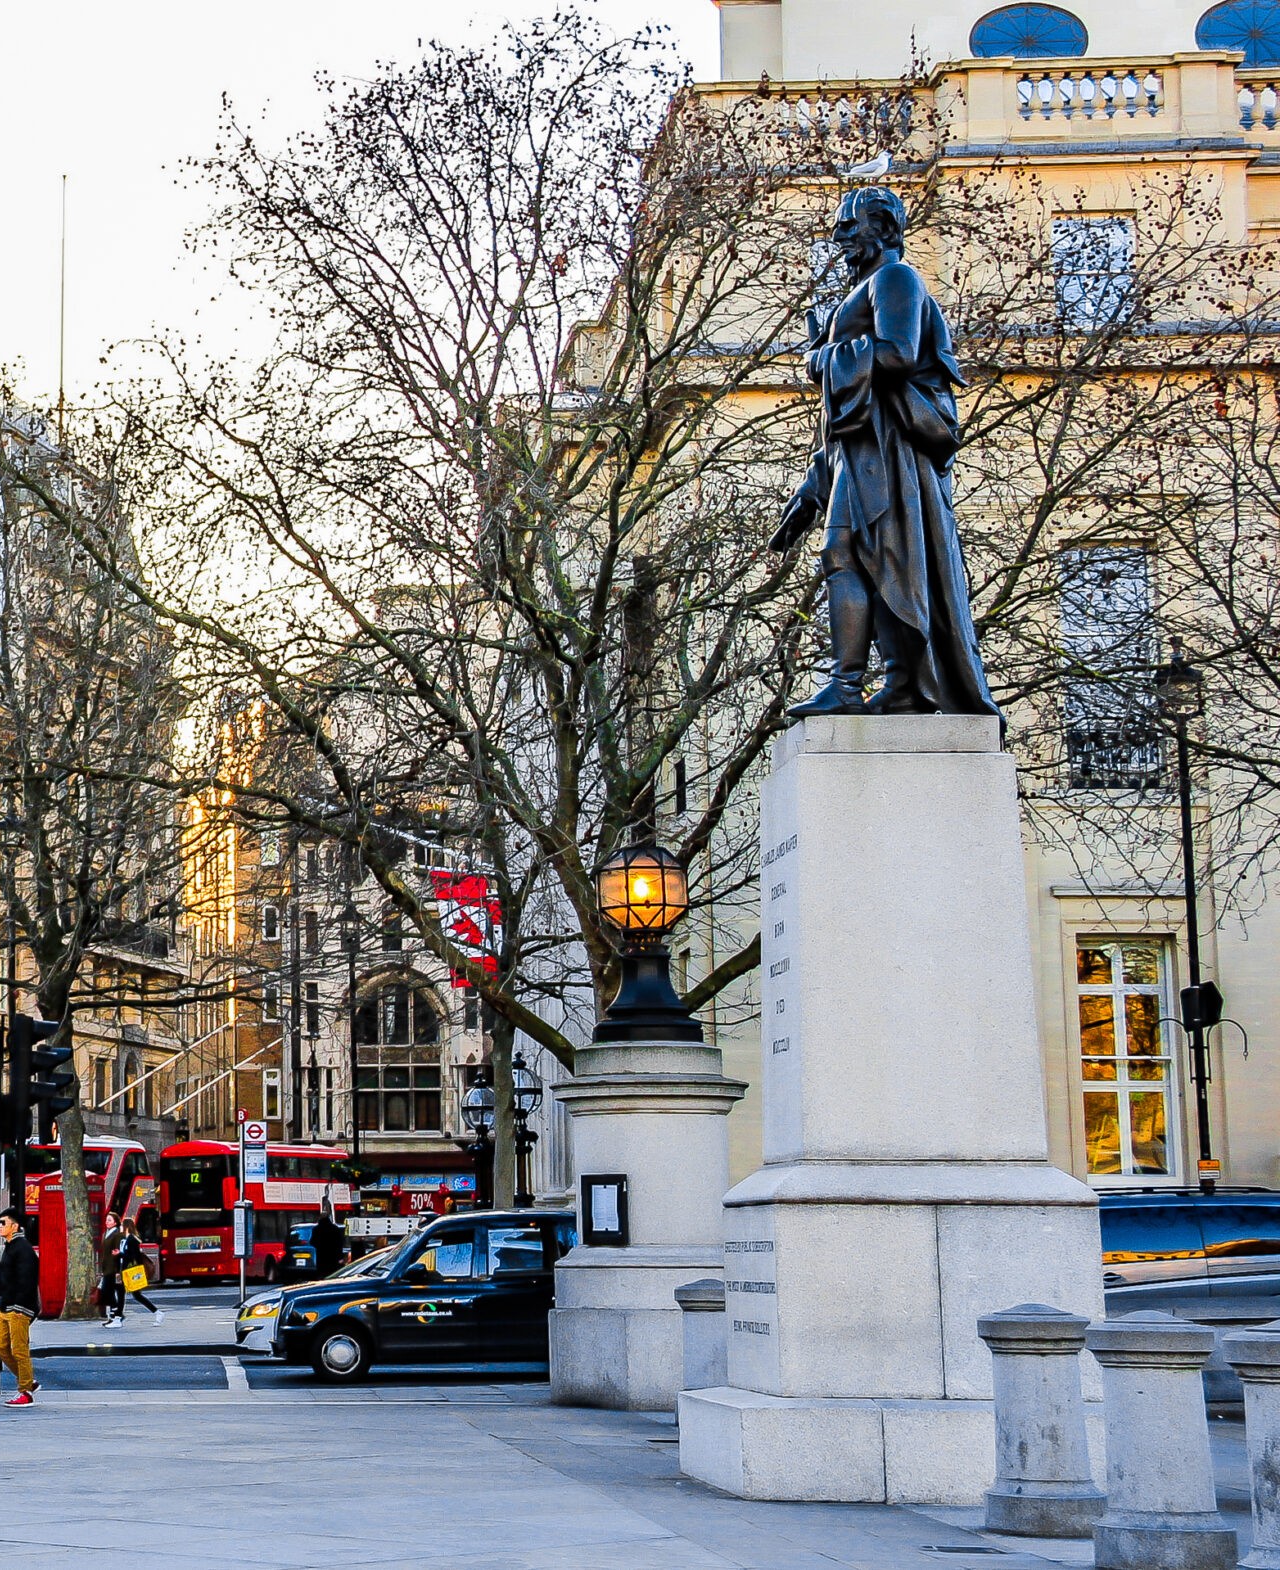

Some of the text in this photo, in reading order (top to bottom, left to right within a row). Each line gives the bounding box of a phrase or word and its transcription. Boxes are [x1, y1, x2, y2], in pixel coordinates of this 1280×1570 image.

[238, 1110, 245, 1120] B
[190, 1172, 201, 1184] 12
[410, 1193, 434, 1211] 50%
